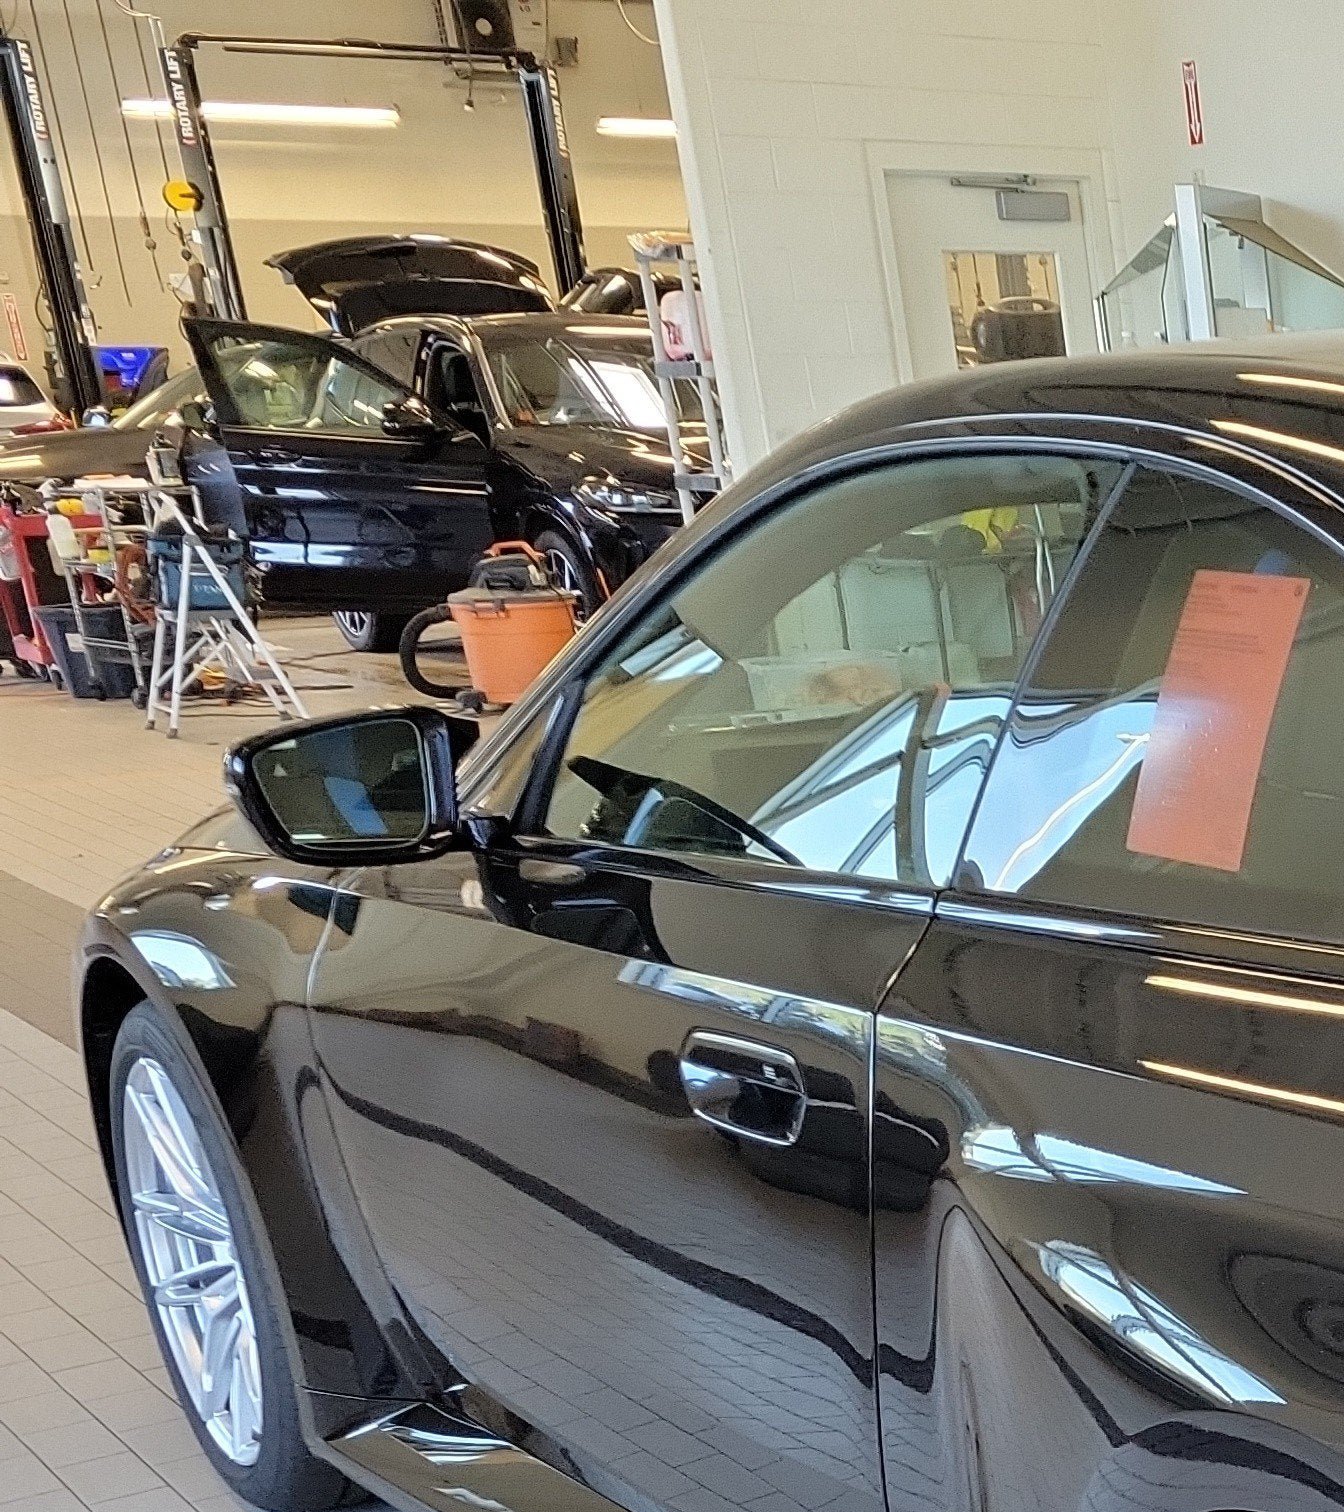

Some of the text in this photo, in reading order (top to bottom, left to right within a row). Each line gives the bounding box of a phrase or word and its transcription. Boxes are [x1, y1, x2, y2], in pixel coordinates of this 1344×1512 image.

[15, 40, 47, 132] ROTARY LIFT
[164, 49, 195, 138] ROTARY LIFT
